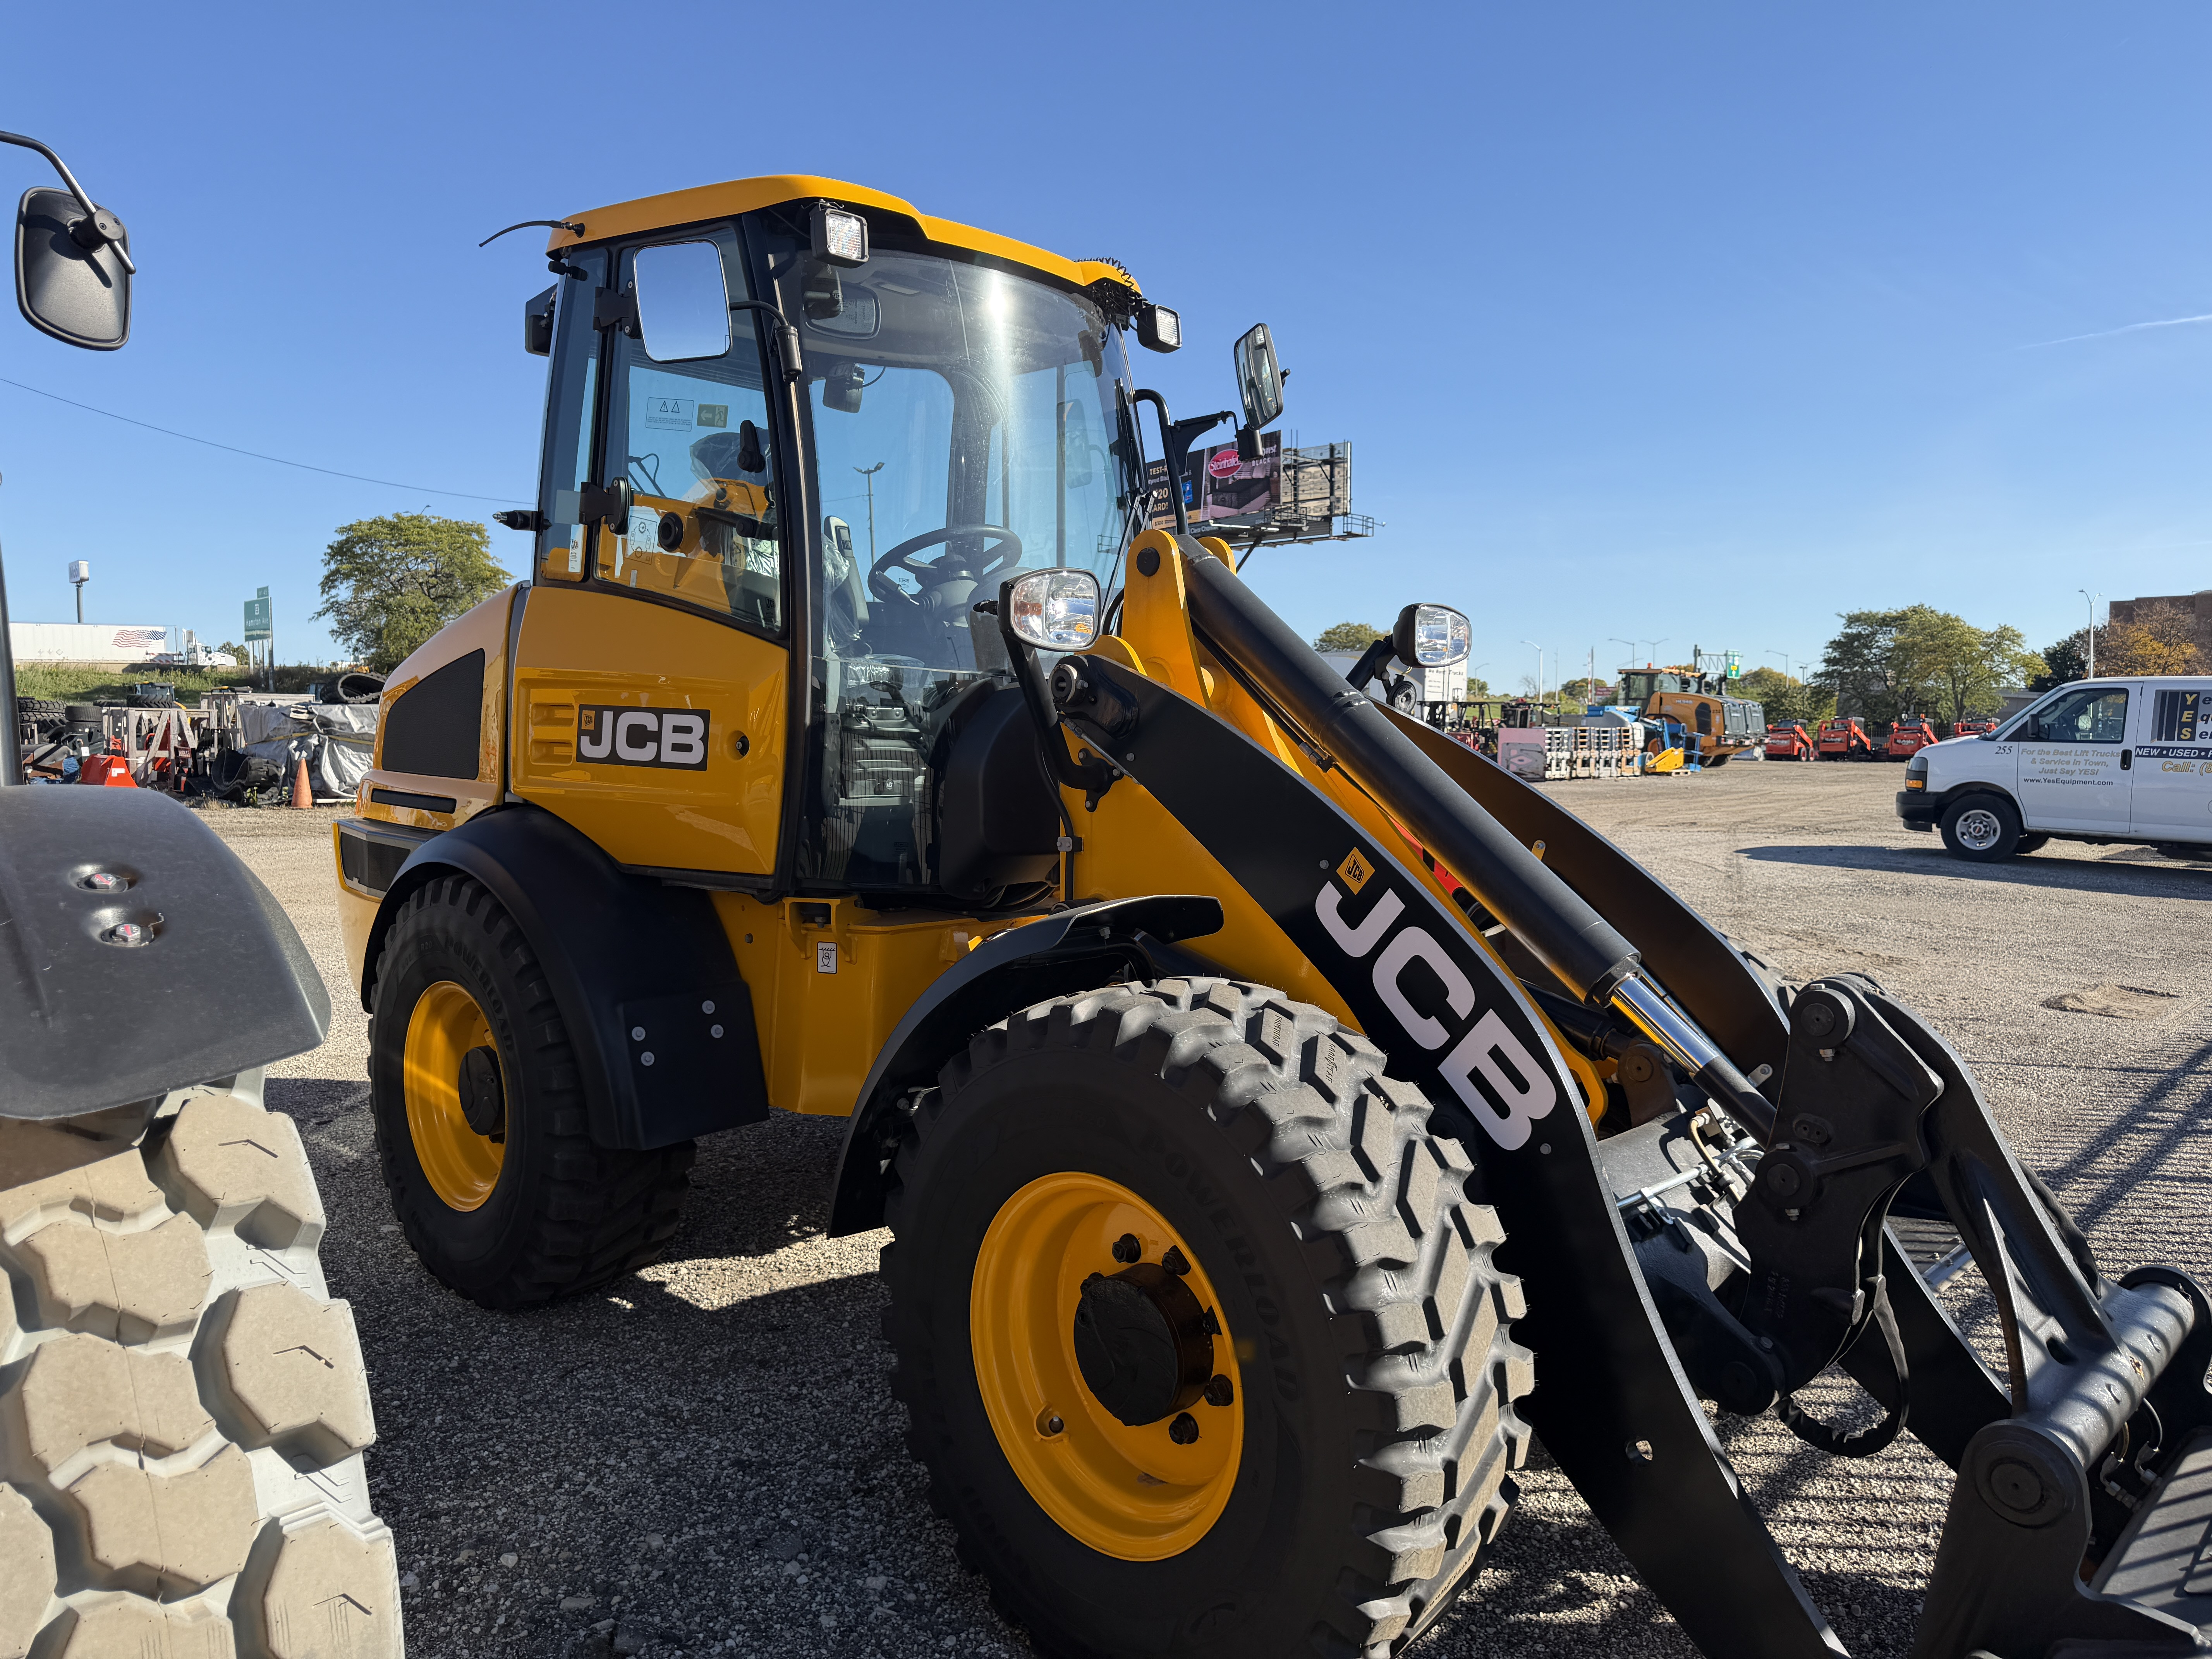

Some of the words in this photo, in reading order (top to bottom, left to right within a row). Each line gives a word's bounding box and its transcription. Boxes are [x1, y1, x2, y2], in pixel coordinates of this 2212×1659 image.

[580, 711, 705, 765] JCB
[1995, 746, 2013, 755] 255
[2168, 749, 2199, 757] USED
[2083, 759, 2109, 767] Town,
[2162, 761, 2195, 773] Call:
[2023, 778, 2113, 786] www.YesEquipment.com
[1347, 859, 1363, 881] JCB
[445, 934, 514, 1052] POWERLOAD
[1315, 881, 1557, 1151] JCB
[1139, 1128, 1299, 1402] POWERLOAD
